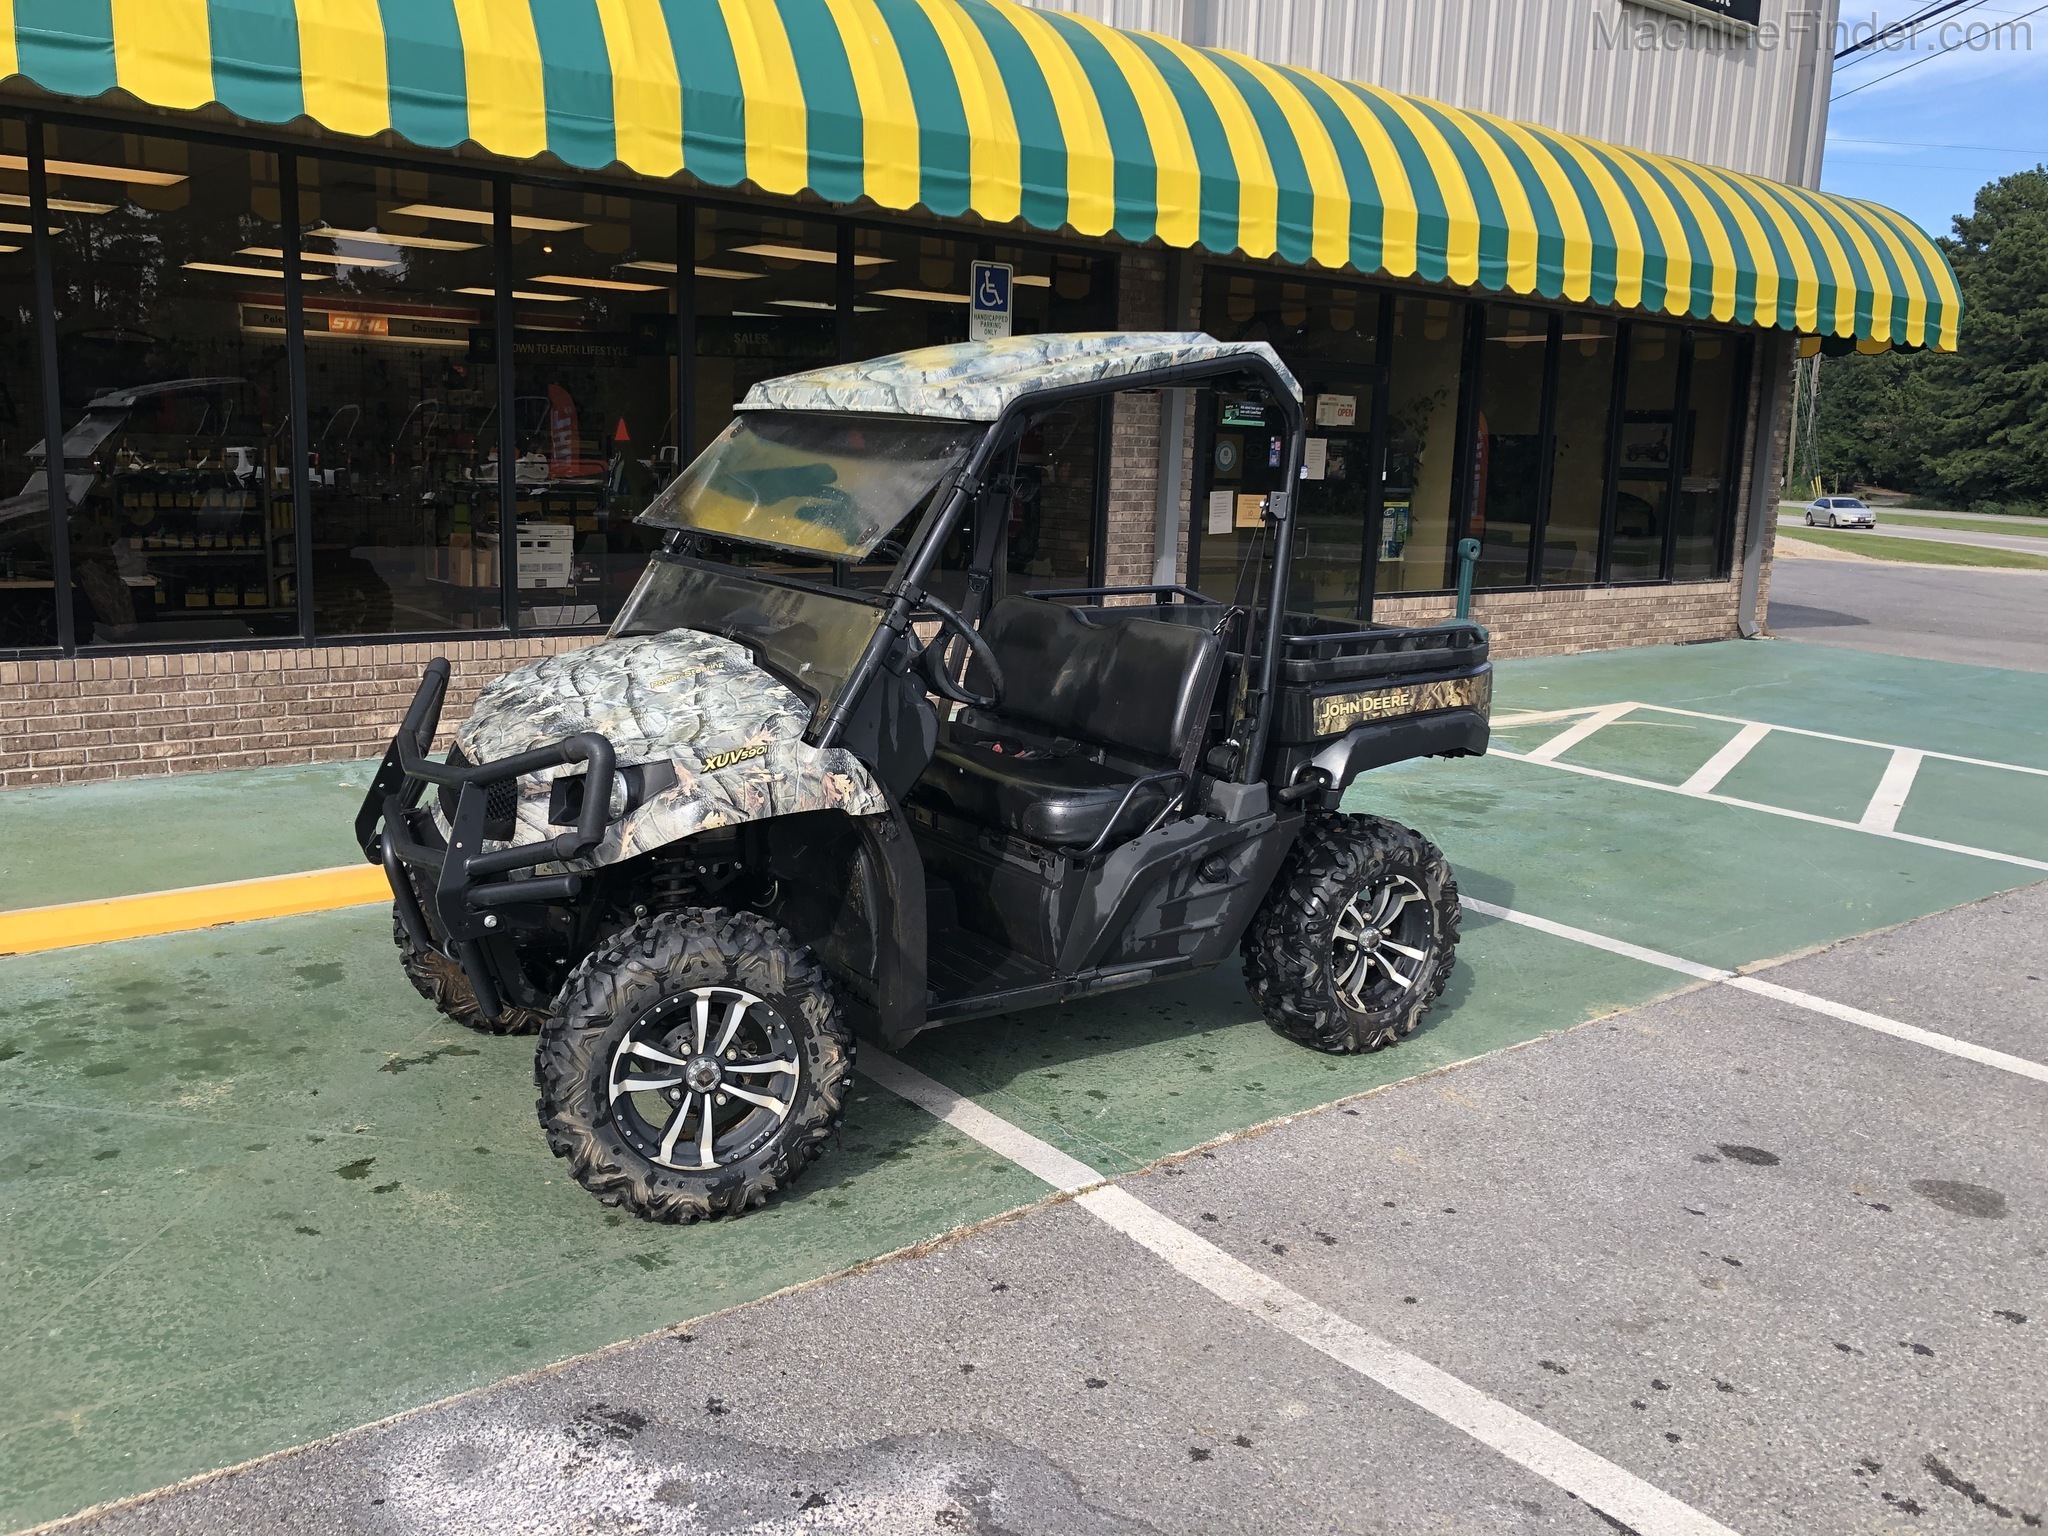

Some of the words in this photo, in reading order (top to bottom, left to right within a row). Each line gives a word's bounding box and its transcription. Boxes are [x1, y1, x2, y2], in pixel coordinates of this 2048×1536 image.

[263, 314, 284, 324] Pole
[331, 317, 386, 332] STIHL
[974, 313, 1008, 323] HANDICAPPED
[412, 325, 456, 335] Chainsaws
[980, 321, 1001, 329] PARKING
[733, 332, 768, 345] SALES
[513, 344, 534, 354] OWN
[537, 345, 548, 354] TO
[551, 345, 579, 355] EARTH
[582, 345, 629, 357] LIFESTYLE
[1338, 408, 1353, 417] OPEN
[650, 675, 681, 688] Power
[684, 662, 724, 677] Steering
[1321, 702, 1360, 719] JOHN
[1362, 693, 1410, 711] DEERE
[701, 745, 769, 773] XUV590i
